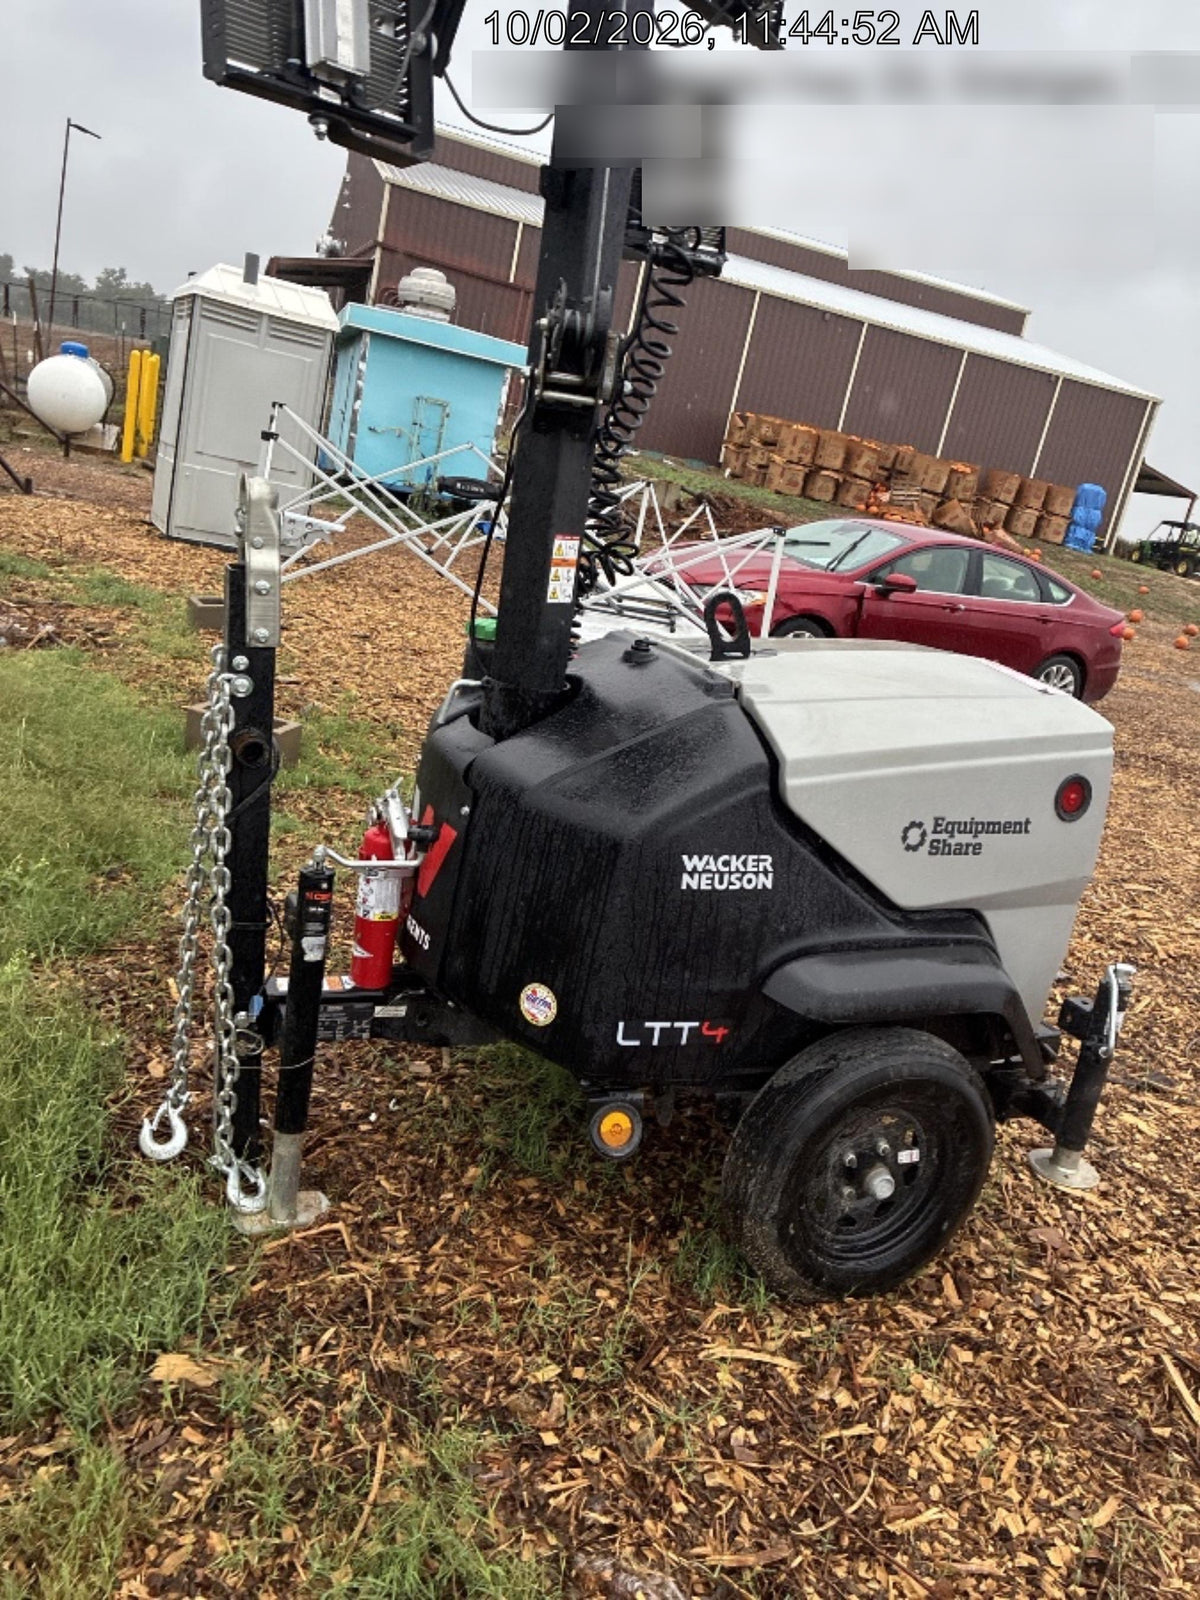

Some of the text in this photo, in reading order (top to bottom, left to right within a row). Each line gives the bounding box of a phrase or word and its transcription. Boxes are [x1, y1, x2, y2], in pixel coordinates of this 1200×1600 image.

[931, 816, 1032, 839] Equipment
[927, 838, 983, 856] Share
[681, 854, 774, 872] WACKER
[680, 872, 774, 891] NEUSON
[616, 1021, 729, 1046] LTT4
